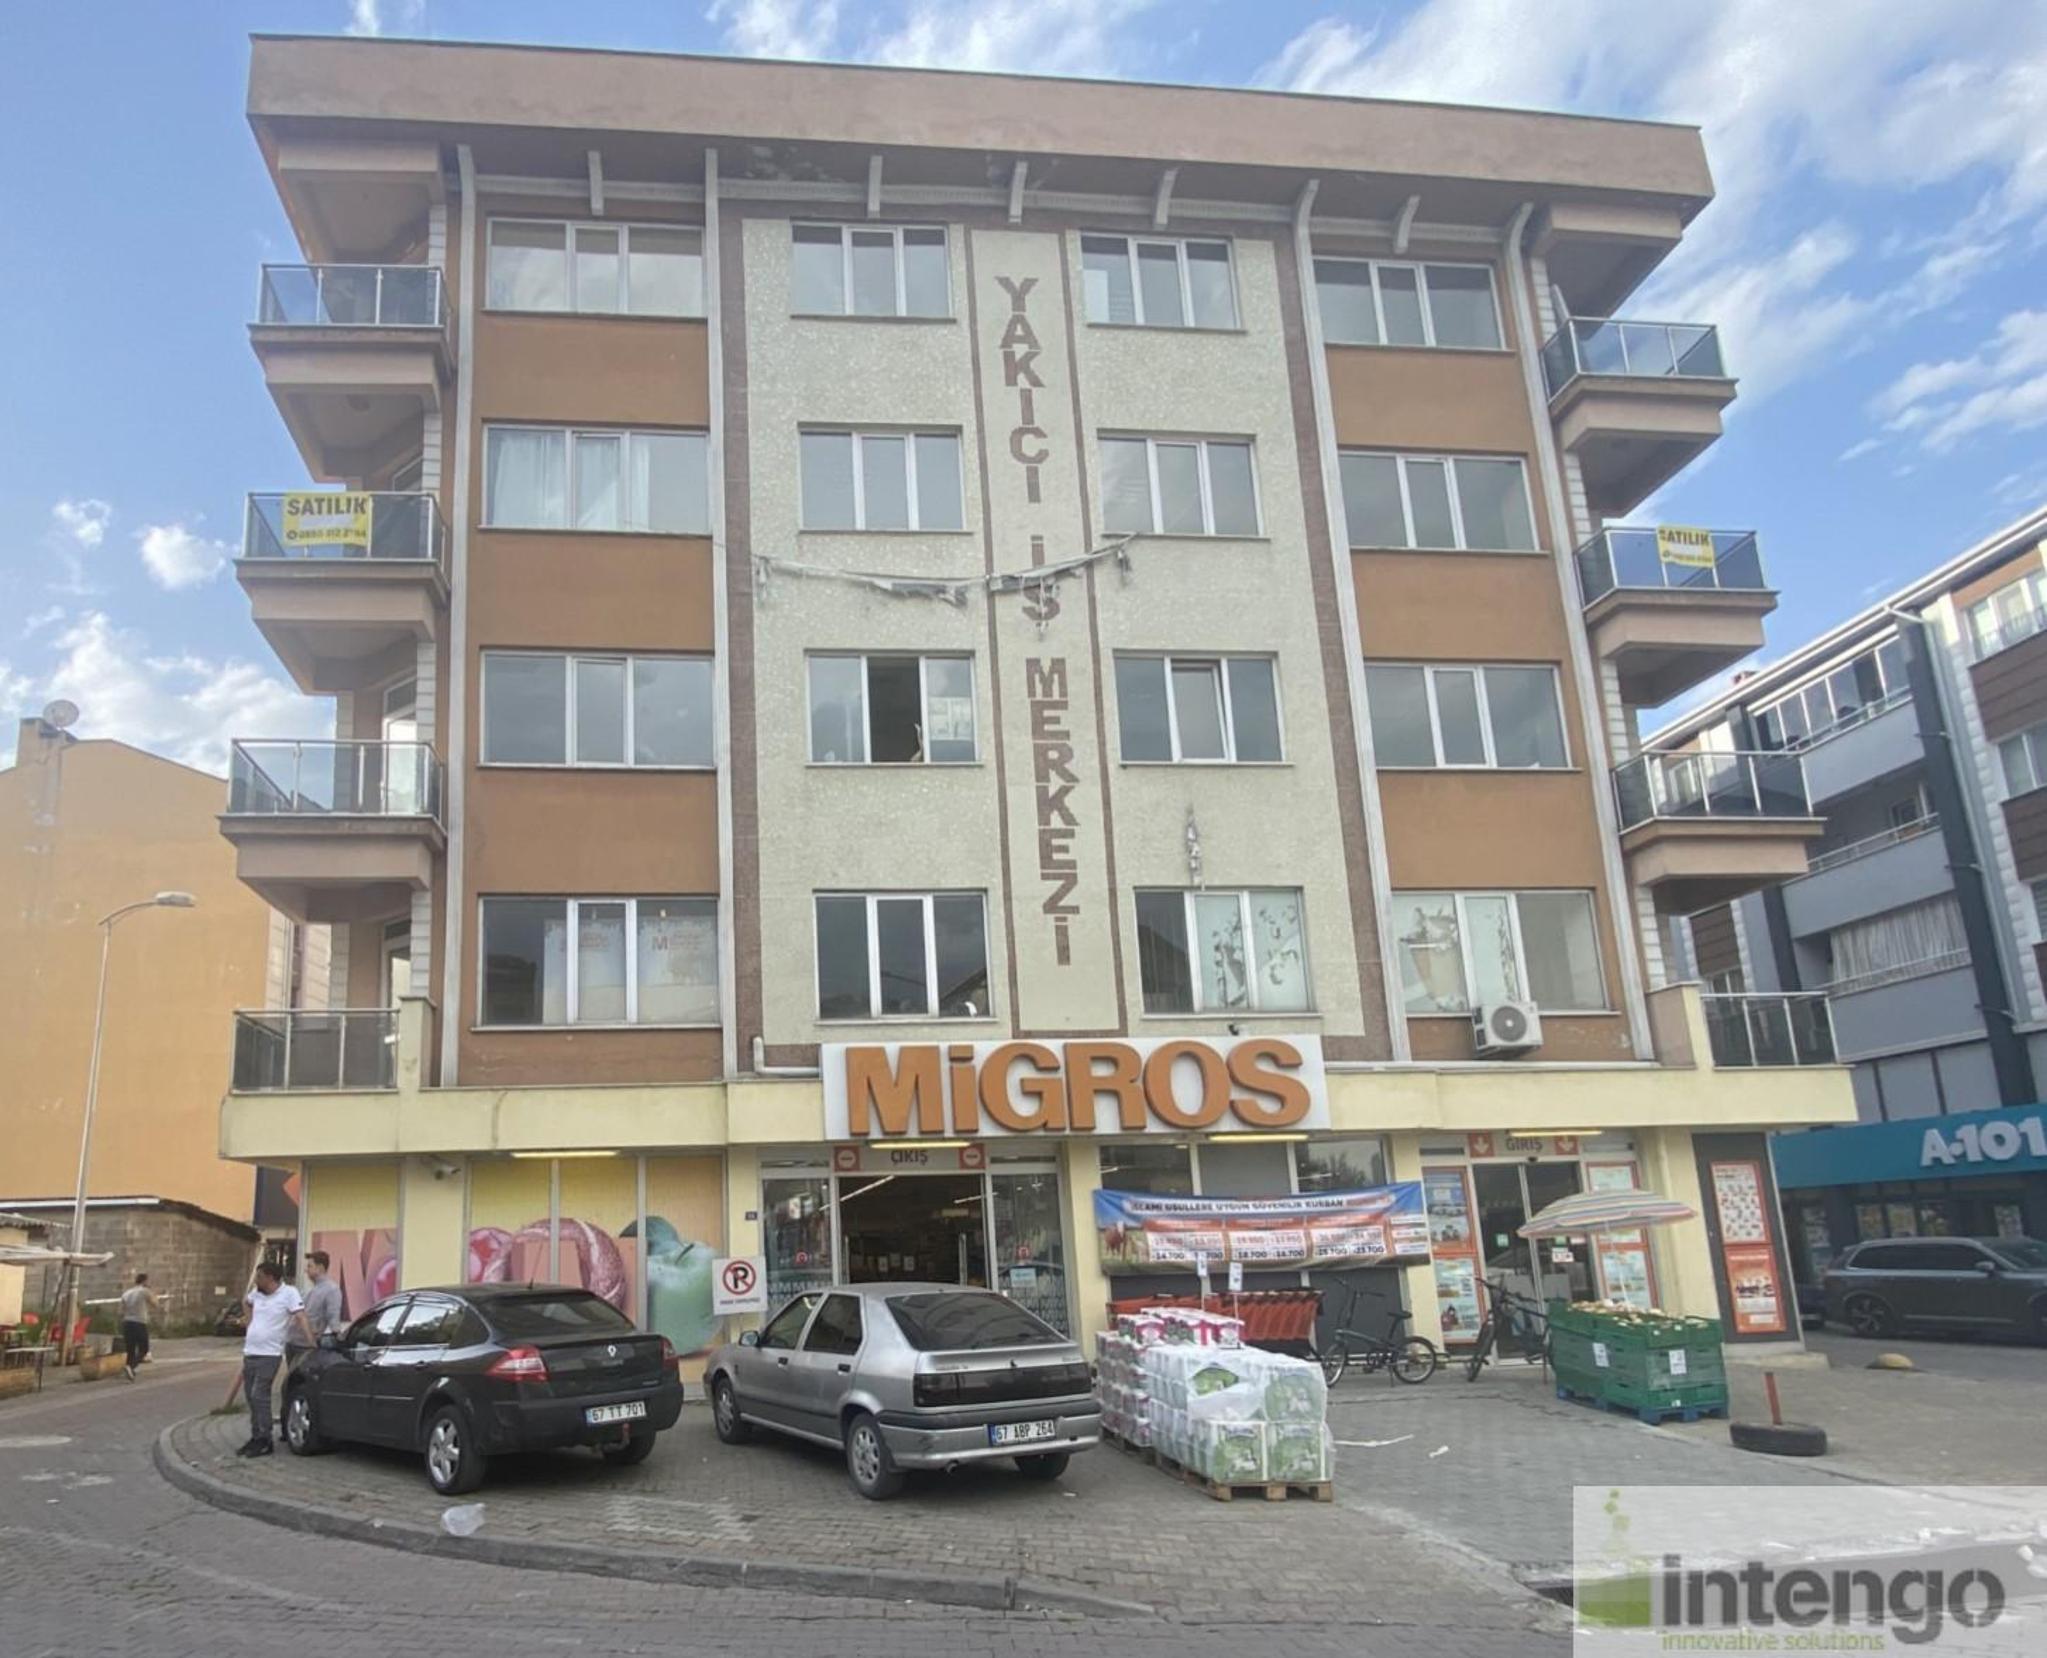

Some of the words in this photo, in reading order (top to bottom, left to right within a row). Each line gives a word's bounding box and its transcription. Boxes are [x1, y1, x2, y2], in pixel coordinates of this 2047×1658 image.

[287, 496, 367, 516] SATILIK
[994, 276, 1050, 504] YAKICI
[1025, 657, 1081, 966] MERKEZİ
